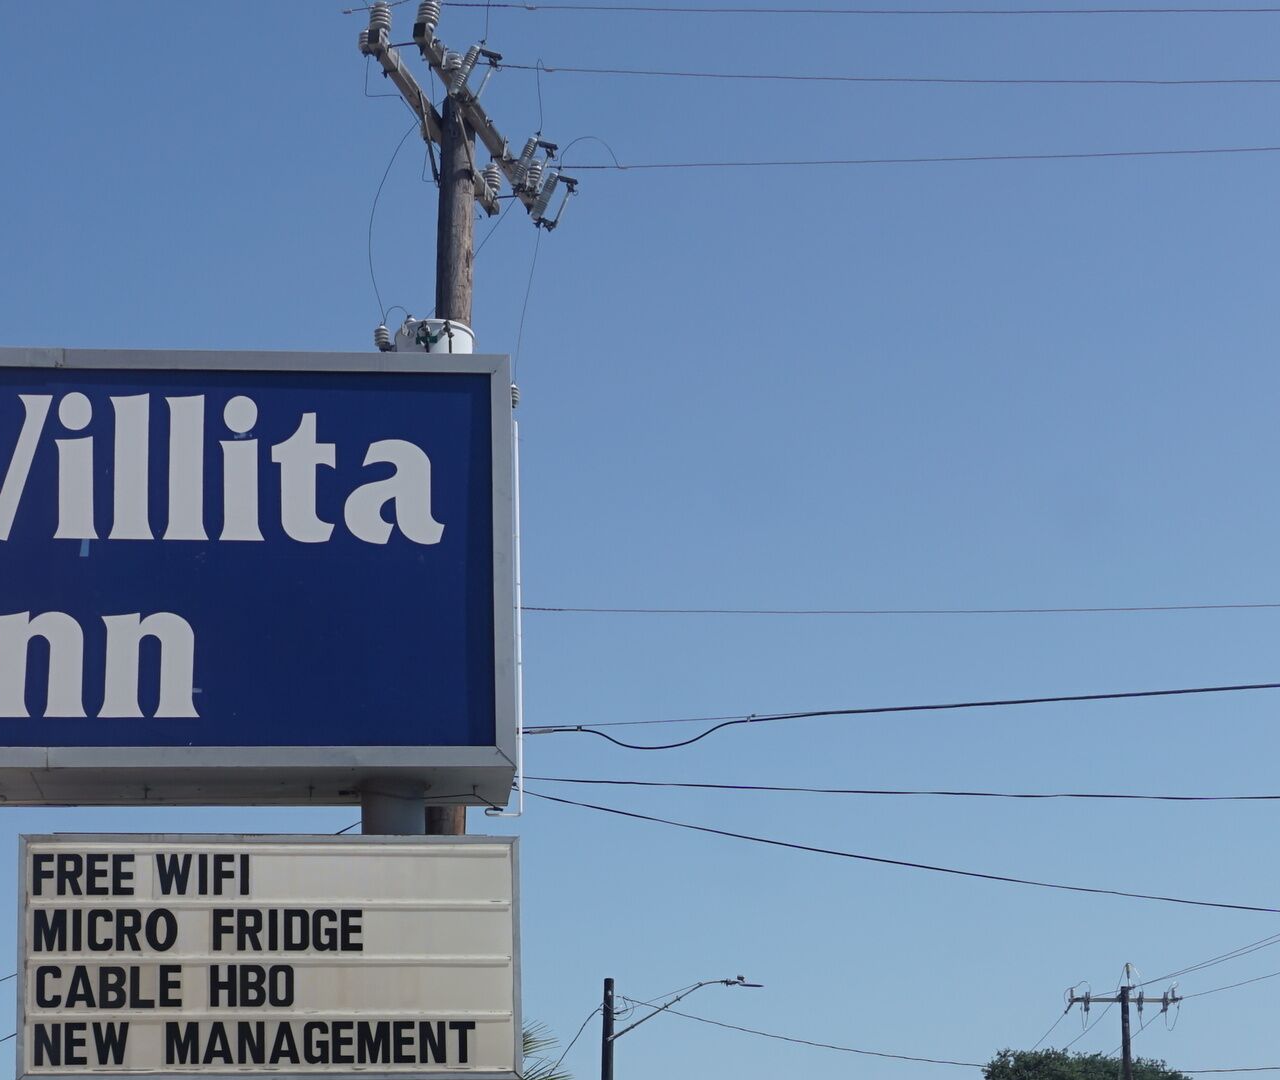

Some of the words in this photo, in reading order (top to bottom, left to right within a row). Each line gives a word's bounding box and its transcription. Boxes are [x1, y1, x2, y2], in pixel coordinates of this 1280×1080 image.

[32, 854, 135, 896] FREE
[156, 854, 250, 896] WIFI
[33, 908, 178, 952] MICRO
[212, 909, 363, 951] FRIDGE
[36, 965, 182, 1009] CABLE
[210, 965, 294, 1008] HBO
[34, 1022, 129, 1066] NEW
[166, 1021, 476, 1064] MANAGEMENT
